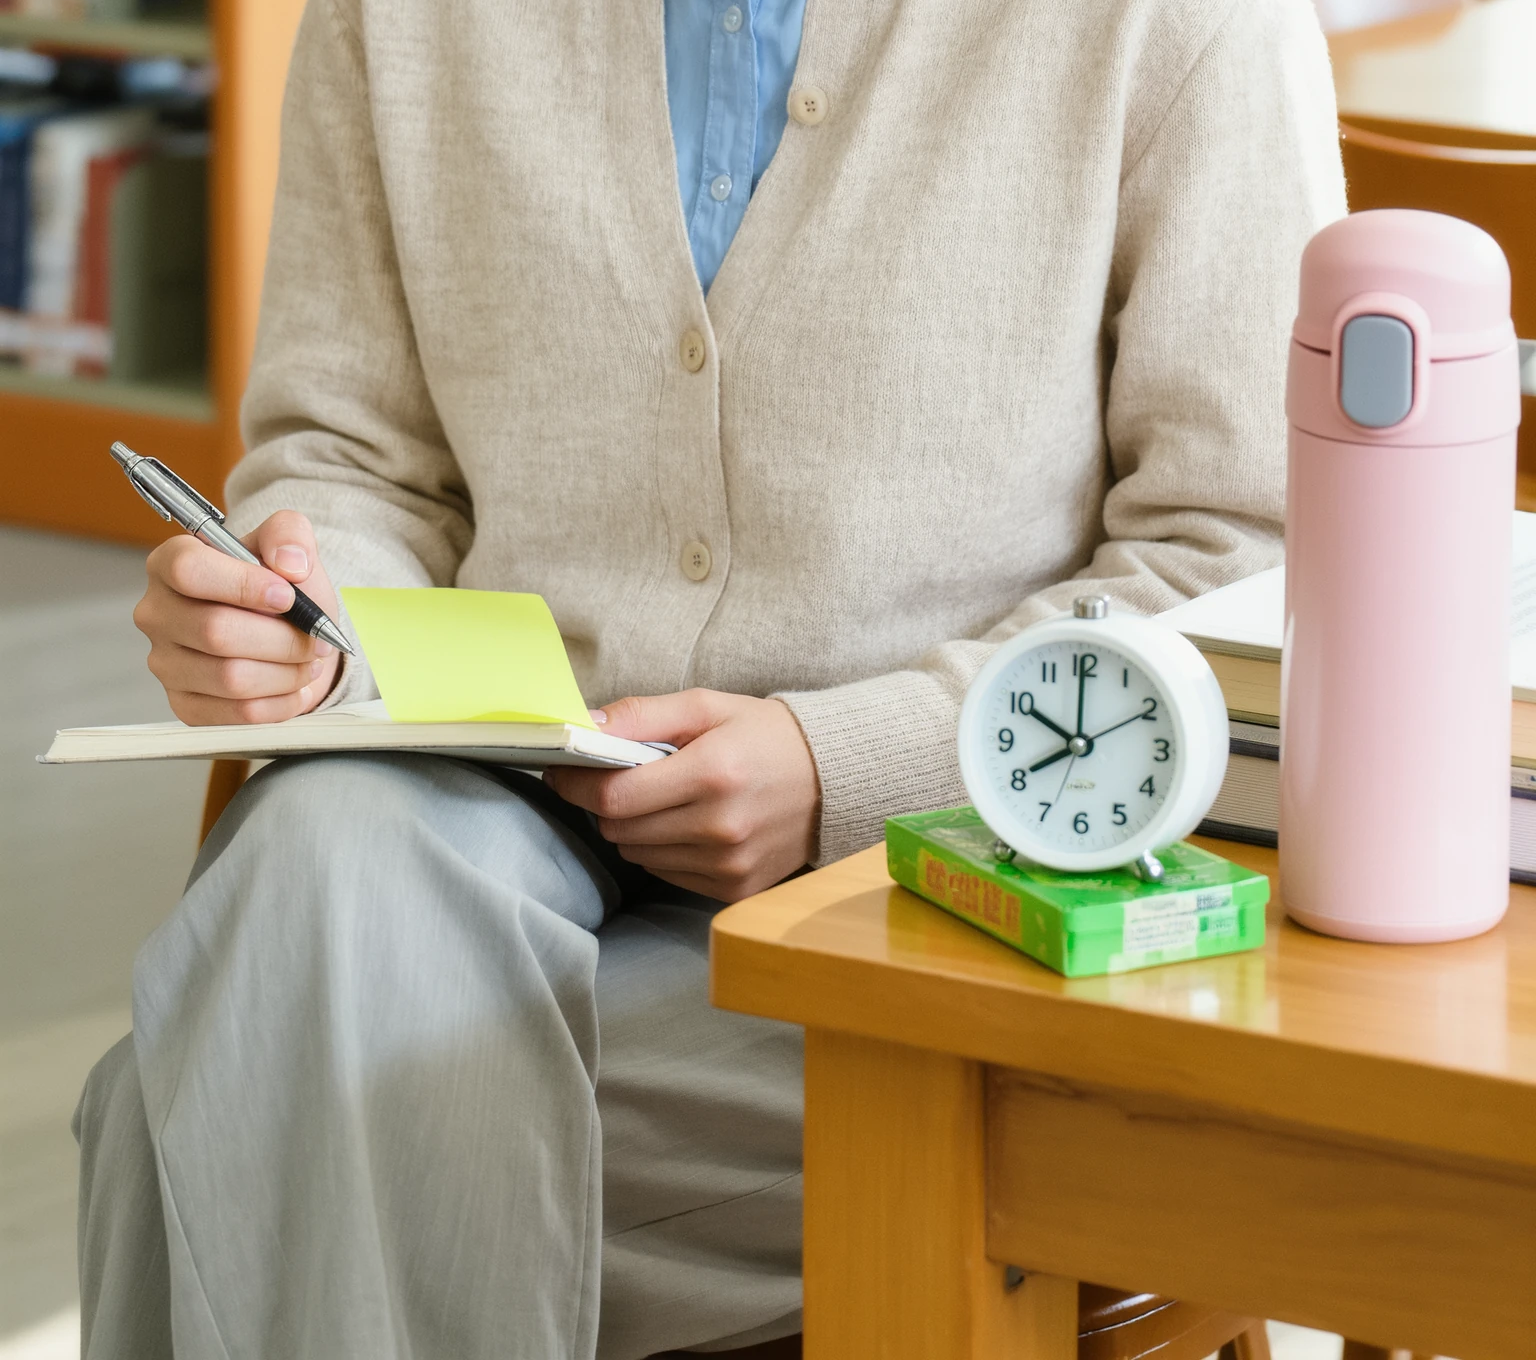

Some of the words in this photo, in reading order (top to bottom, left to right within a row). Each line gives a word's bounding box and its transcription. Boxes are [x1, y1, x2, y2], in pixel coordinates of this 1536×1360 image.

[1042, 661, 1056, 683] 11
[1073, 653, 1098, 678] 12
[1123, 668, 1129, 688] 1
[1011, 691, 1034, 716] 10
[1141, 697, 1158, 721] 2
[998, 728, 1014, 752] 9
[1153, 739, 1170, 763] 3
[1011, 768, 1027, 791] 8
[1139, 775, 1155, 798] 4
[1038, 802, 1052, 822] 7
[1073, 812, 1089, 834] 6
[1112, 803, 1128, 826] 5
